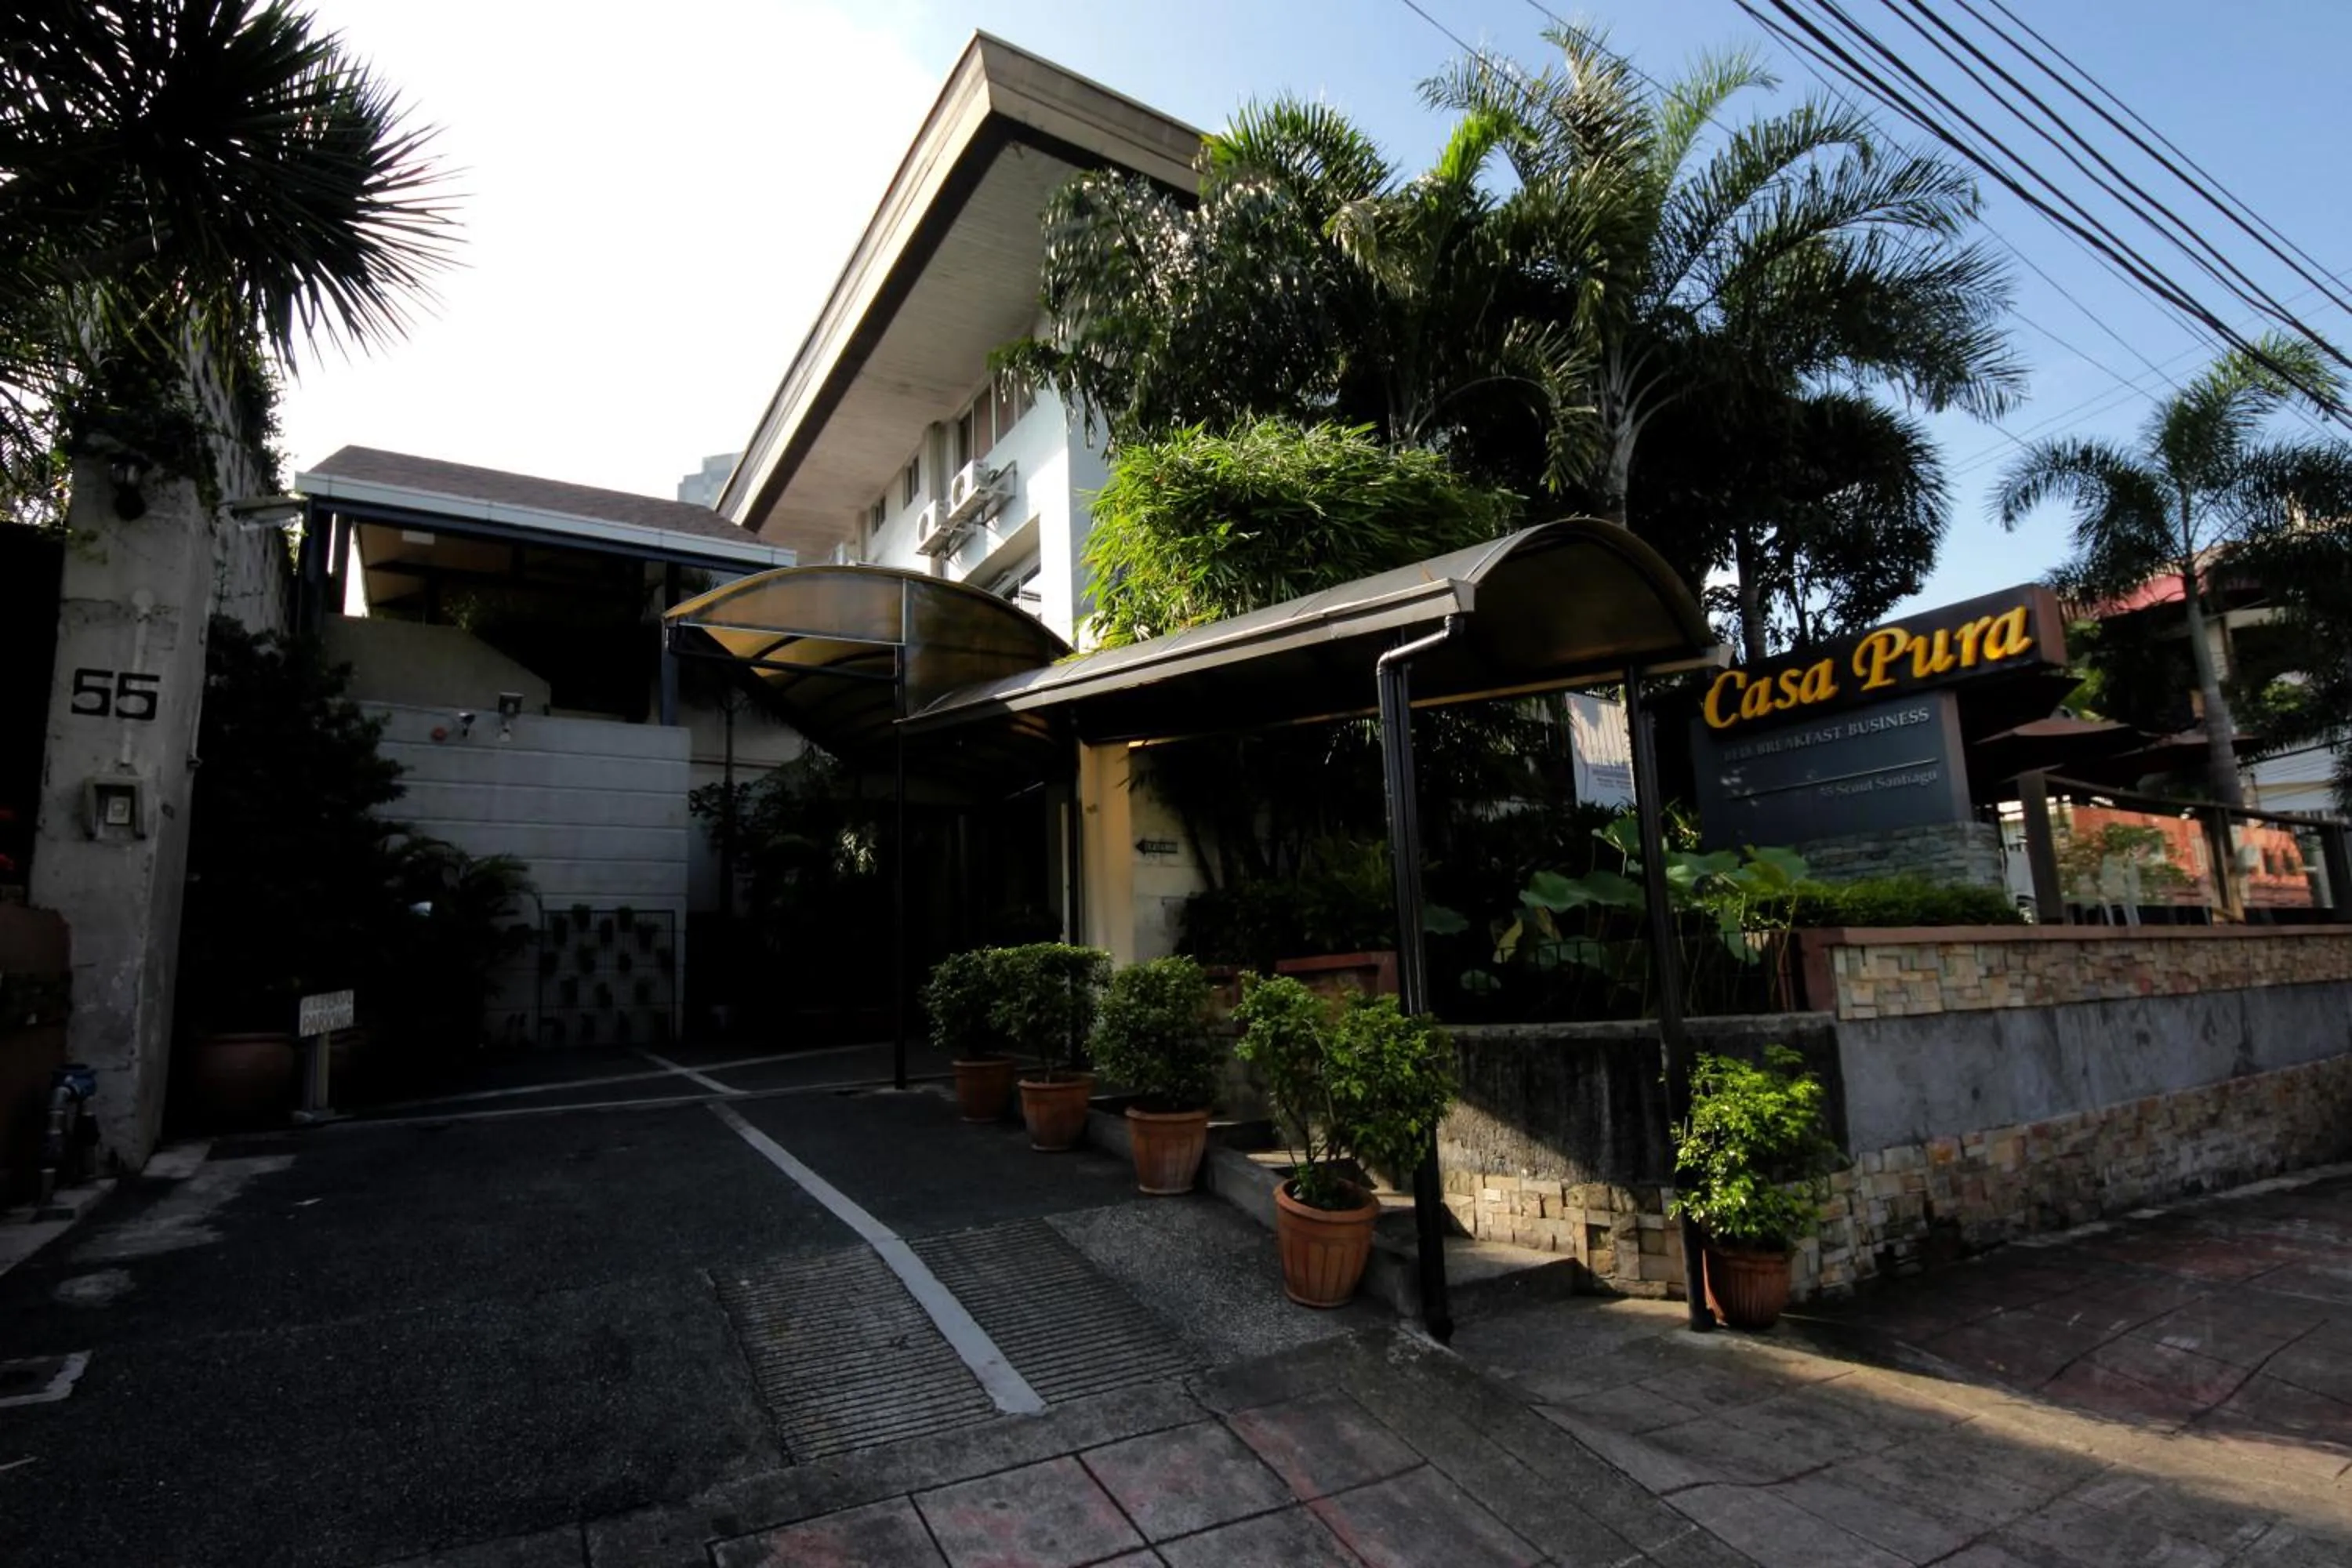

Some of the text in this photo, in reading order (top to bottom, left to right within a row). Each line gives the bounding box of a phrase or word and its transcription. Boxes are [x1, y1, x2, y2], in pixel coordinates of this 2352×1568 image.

[1703, 605, 2035, 730] Casa Pura
[71, 668, 160, 720] 55
[1756, 726, 1842, 755] BREAKFAST
[1848, 706, 1930, 736] BUSINESS
[1875, 769, 1938, 789] Santiago
